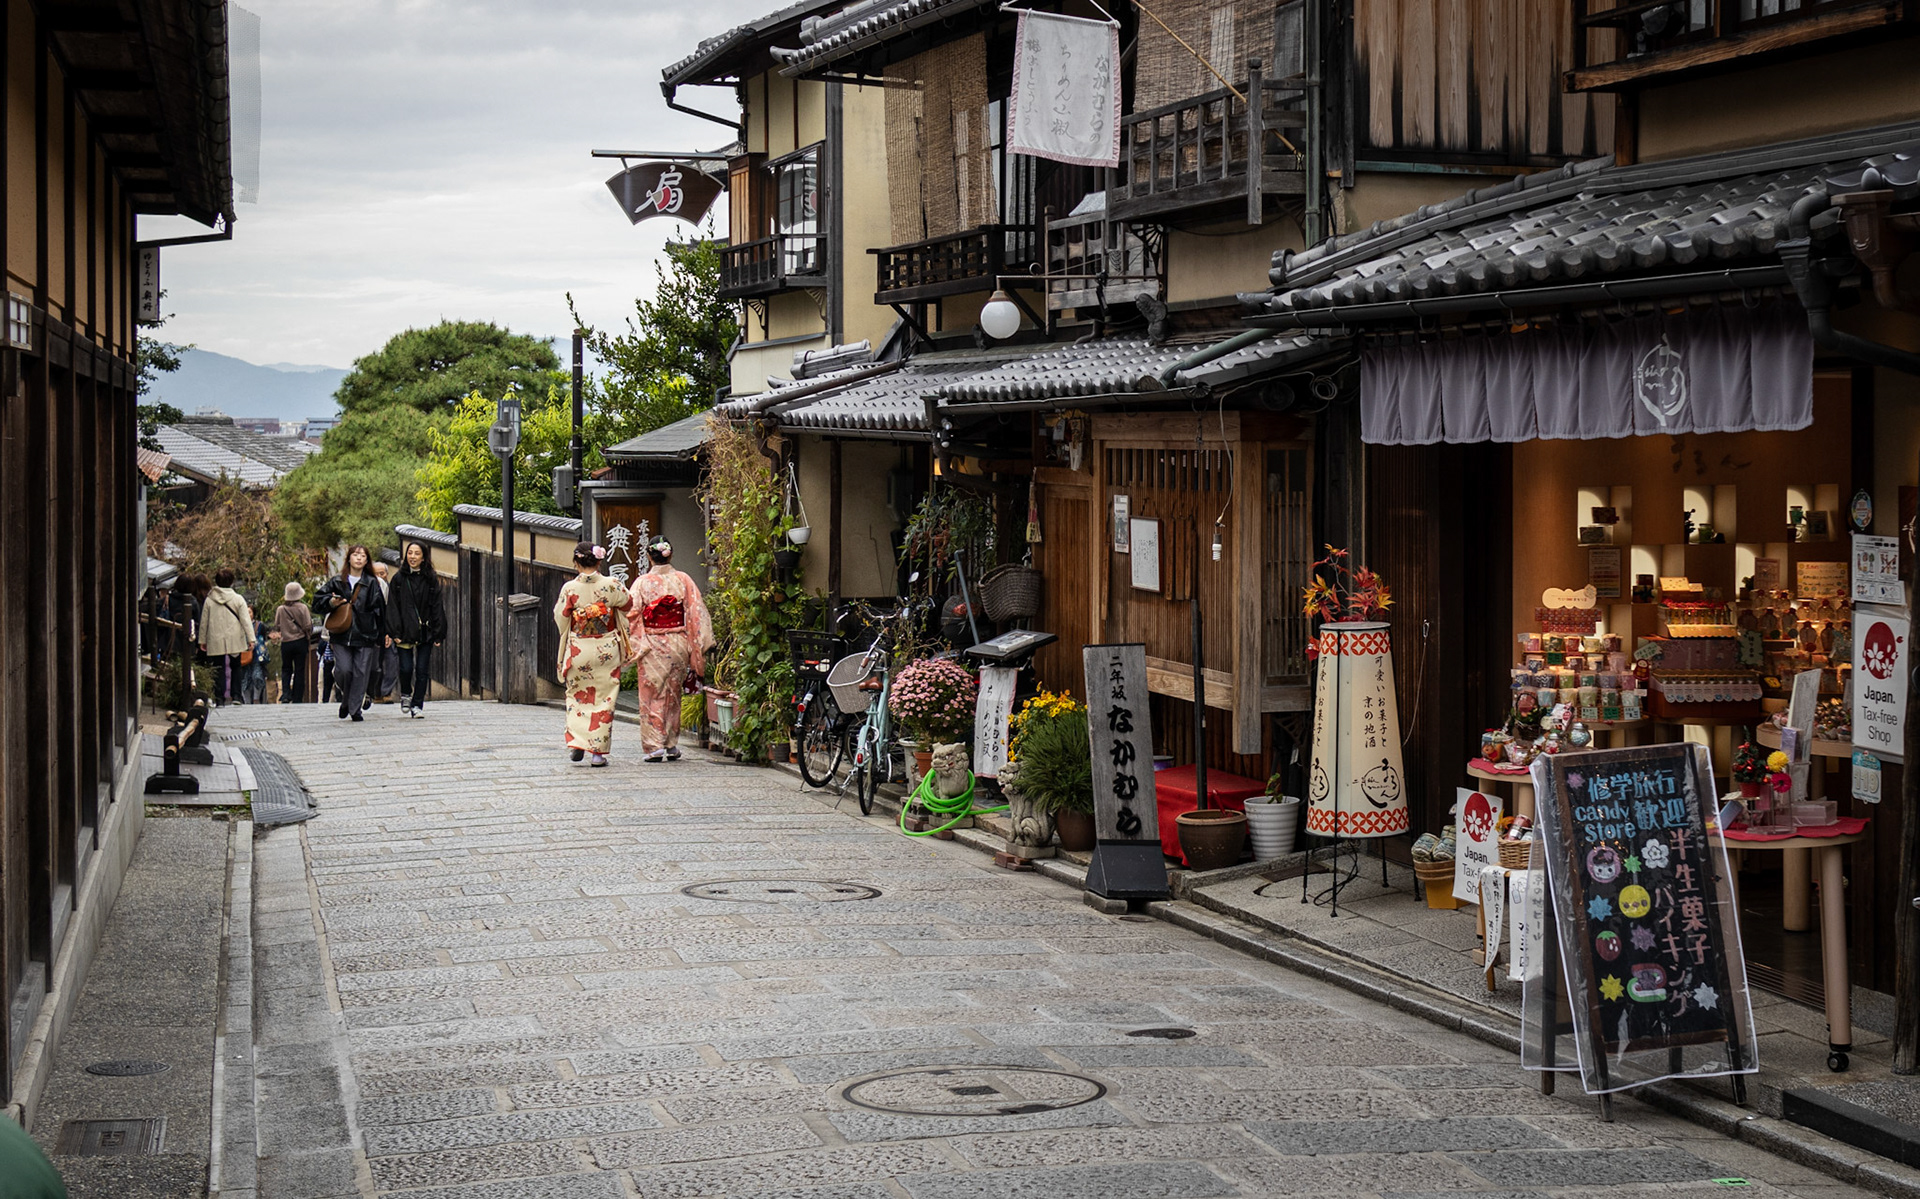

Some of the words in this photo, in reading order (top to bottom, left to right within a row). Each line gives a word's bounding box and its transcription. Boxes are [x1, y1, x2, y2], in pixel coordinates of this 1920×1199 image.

[1109, 655, 1127, 701] 二年坂
[1374, 655, 1387, 692] 可愛い
[1863, 685, 1896, 704] Japan.
[1363, 695, 1377, 749] 京の地酒
[1377, 697, 1388, 748] お菓子と
[1861, 705, 1898, 726] Tax-free
[1868, 725, 1891, 746] Shop
[1106, 704, 1142, 836] なかむら
[1587, 769, 1676, 803] 修学旅行
[1575, 801, 1630, 822] candy
[1633, 798, 1690, 830] 歓迎
[1462, 863, 1481, 881] Tax-f
[1463, 846, 1490, 866] Japan.
[1670, 827, 1712, 965] 半生菓子
[1655, 885, 1692, 1018] バイキング
